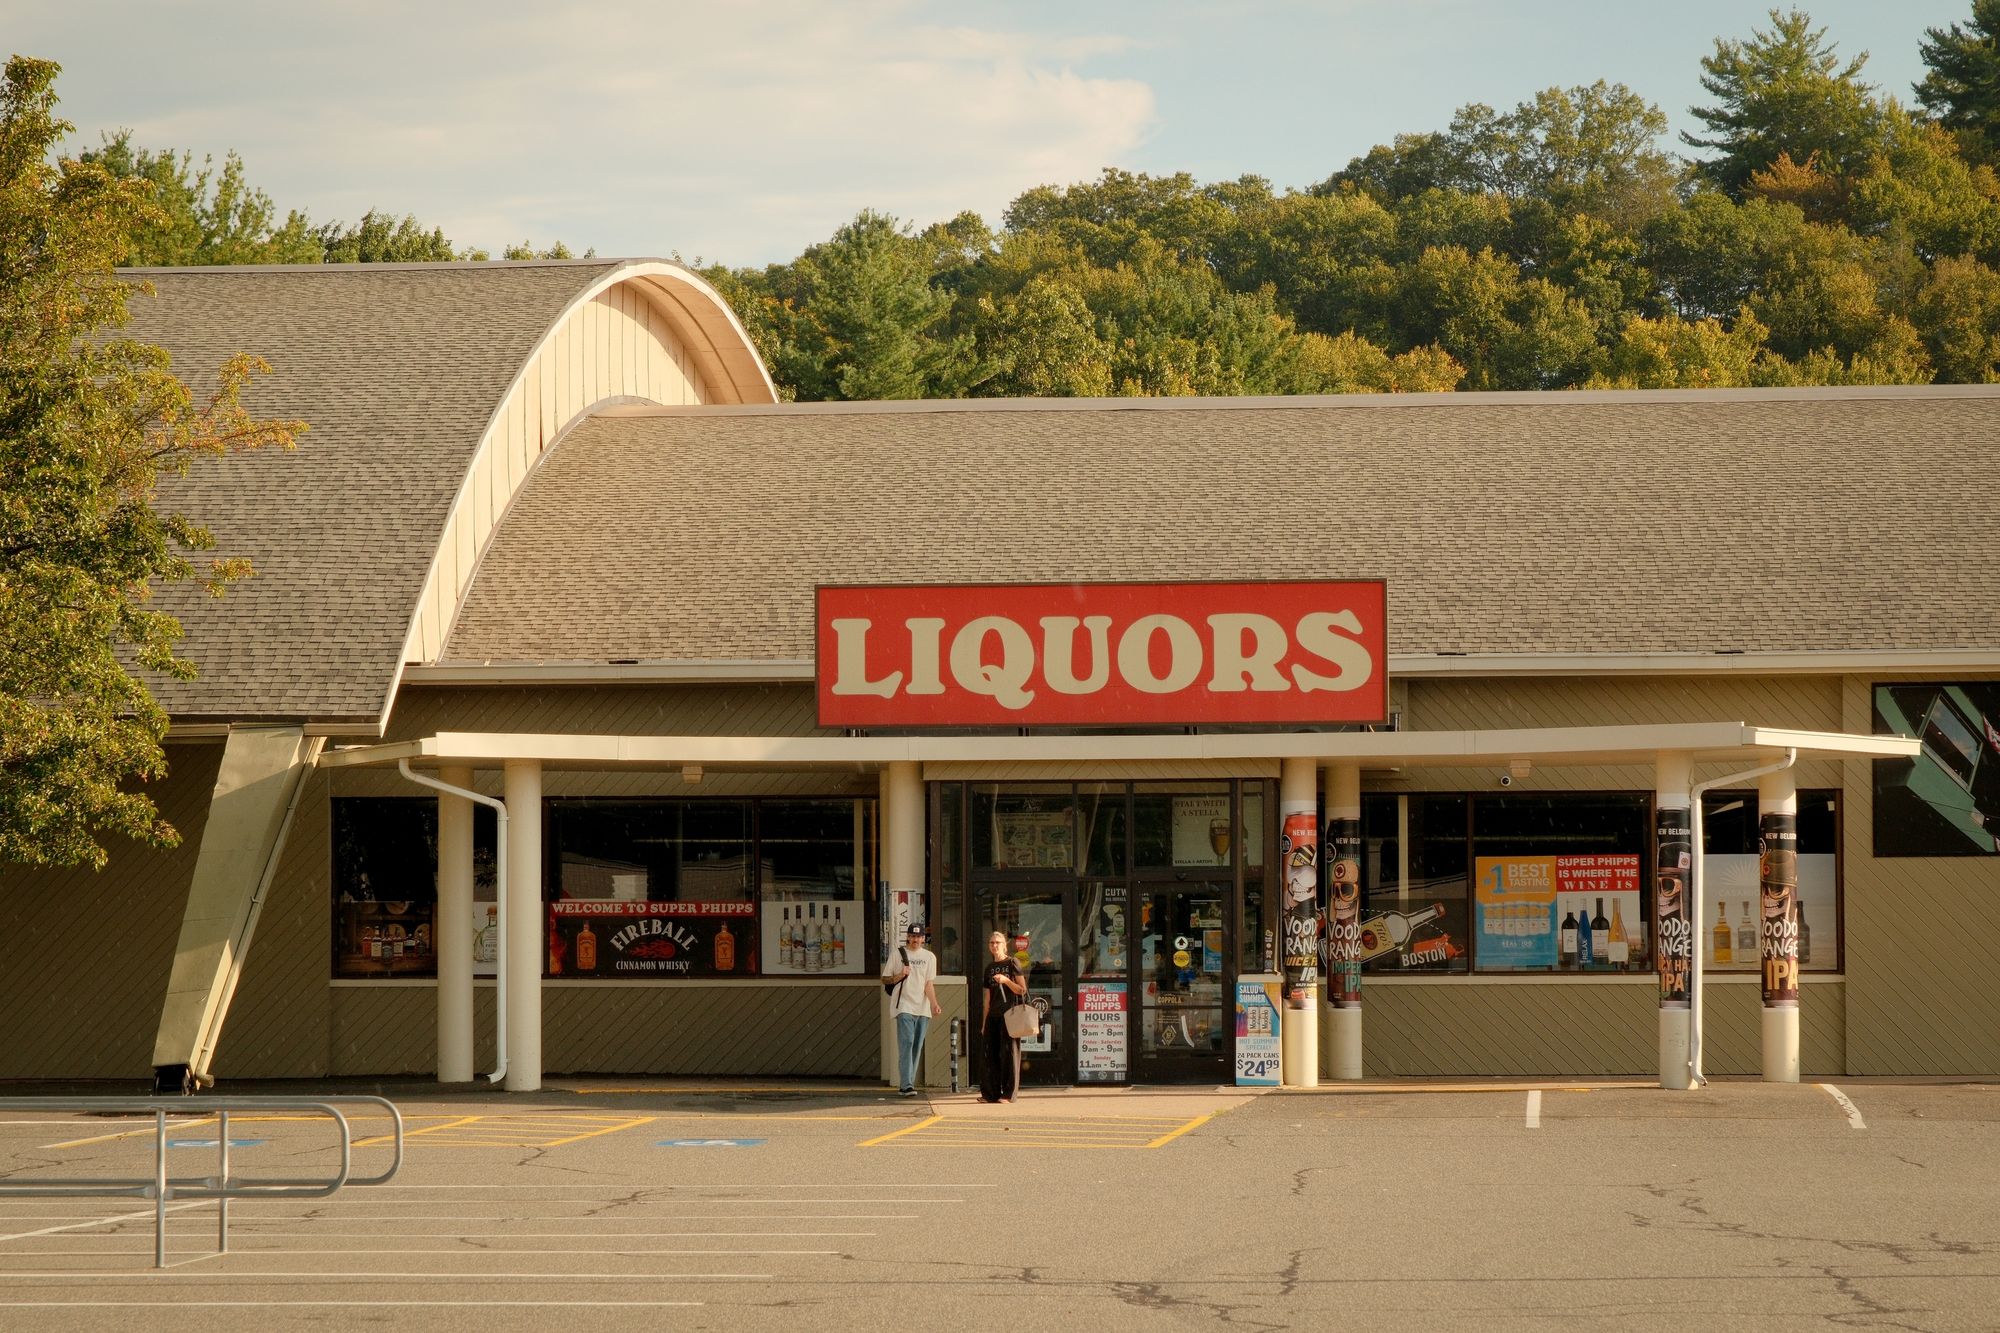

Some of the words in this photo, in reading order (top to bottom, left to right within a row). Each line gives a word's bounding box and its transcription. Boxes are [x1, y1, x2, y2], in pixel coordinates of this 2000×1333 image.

[831, 608, 1373, 710] LIQUORS
[1188, 809, 1220, 817] STELLA
[1292, 829, 1306, 837] NEW
[1557, 857, 1595, 867] SUPER
[1597, 857, 1638, 867] PHIPPS
[1508, 863, 1550, 878] BEST
[1558, 869, 1570, 879] IS
[1572, 869, 1612, 878] WHERE
[1614, 868, 1638, 878] THE
[1508, 878, 1550, 887] TASTING
[1564, 880, 1609, 891] WINE
[1616, 880, 1633, 890] IS
[551, 903, 623, 914] WELCOME
[626, 903, 648, 914] TO
[650, 903, 697, 914] SUPER
[701, 903, 754, 914] PHIPPS
[609, 919, 697, 952] FIREBALL
[1401, 947, 1447, 967] BOSTON
[615, 961, 657, 971] CINNAMON
[658, 961, 691, 973] WHISKY
[1766, 959, 1799, 991] IPA
[1661, 973, 1685, 992] IPA
[1239, 985, 1259, 994] SALUD
[1085, 993, 1120, 1002] SUPER
[1157, 996, 1182, 1004] COPPOLA
[1084, 1002, 1122, 1010] PHIPPS
[1084, 1012, 1121, 1021] HOURS
[1249, 1009, 1257, 1030] Modelo
[1081, 1028, 1099, 1037] 9am
[1106, 1028, 1124, 1037] 8pm
[1081, 1044, 1099, 1053] 9am
[1106, 1044, 1124, 1053] 9pm
[1079, 1060, 1102, 1069] 11am
[1109, 1060, 1127, 1069] 5pm
